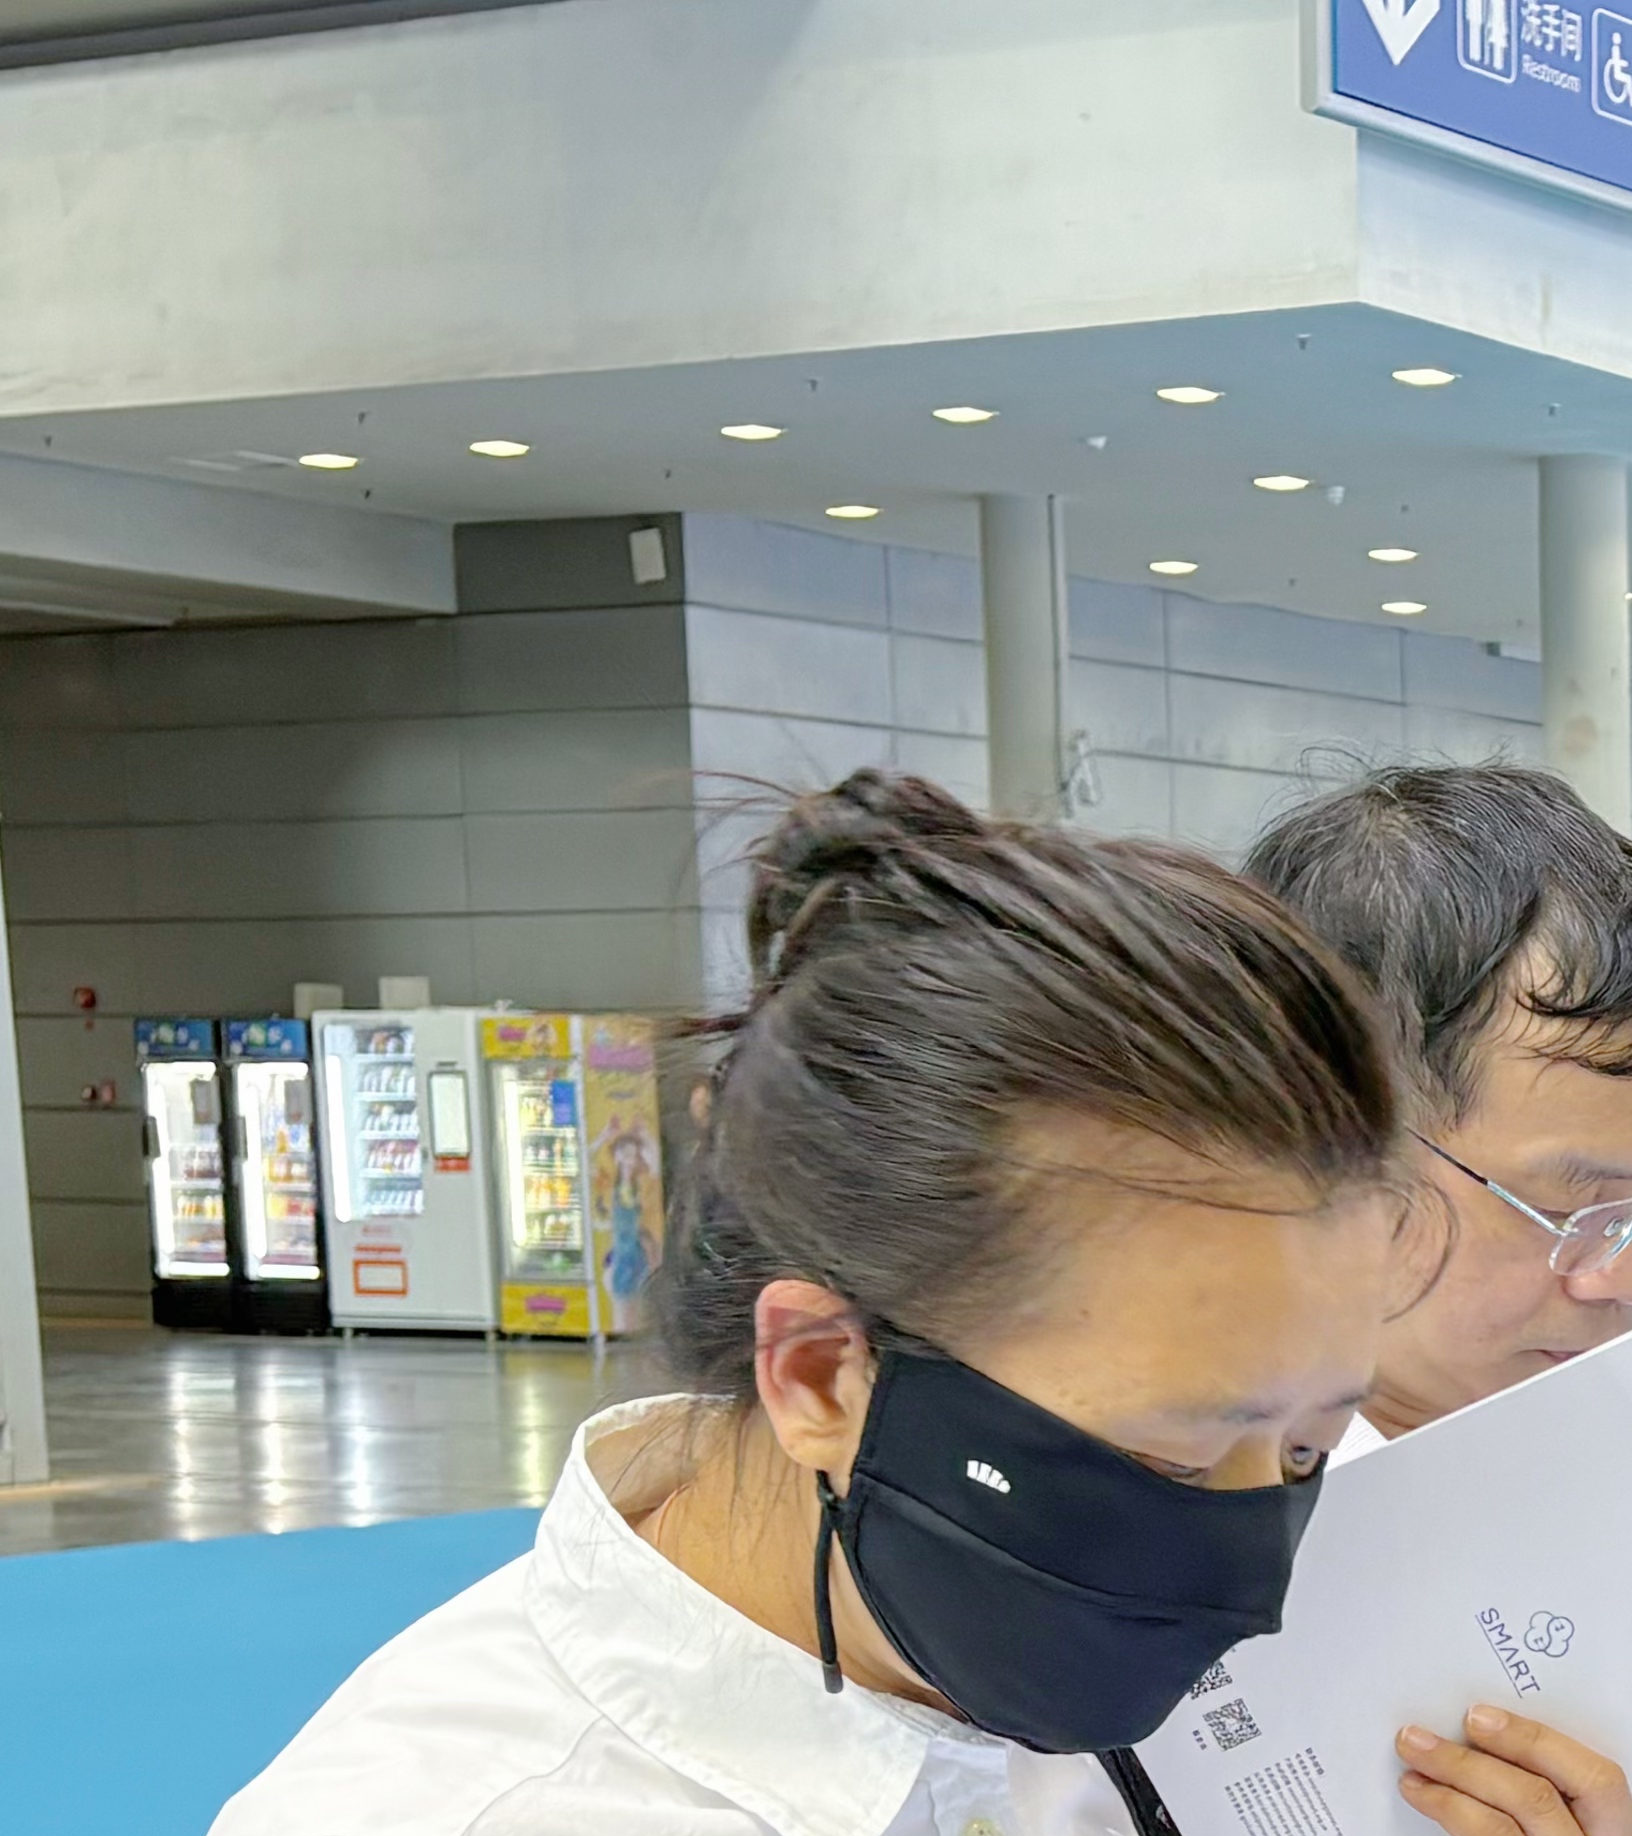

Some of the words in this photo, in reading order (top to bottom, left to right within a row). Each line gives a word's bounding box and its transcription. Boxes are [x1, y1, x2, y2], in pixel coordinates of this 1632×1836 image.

[1521, 0, 1582, 62] 洗手间
[1480, 1606, 1541, 1696] SMART
